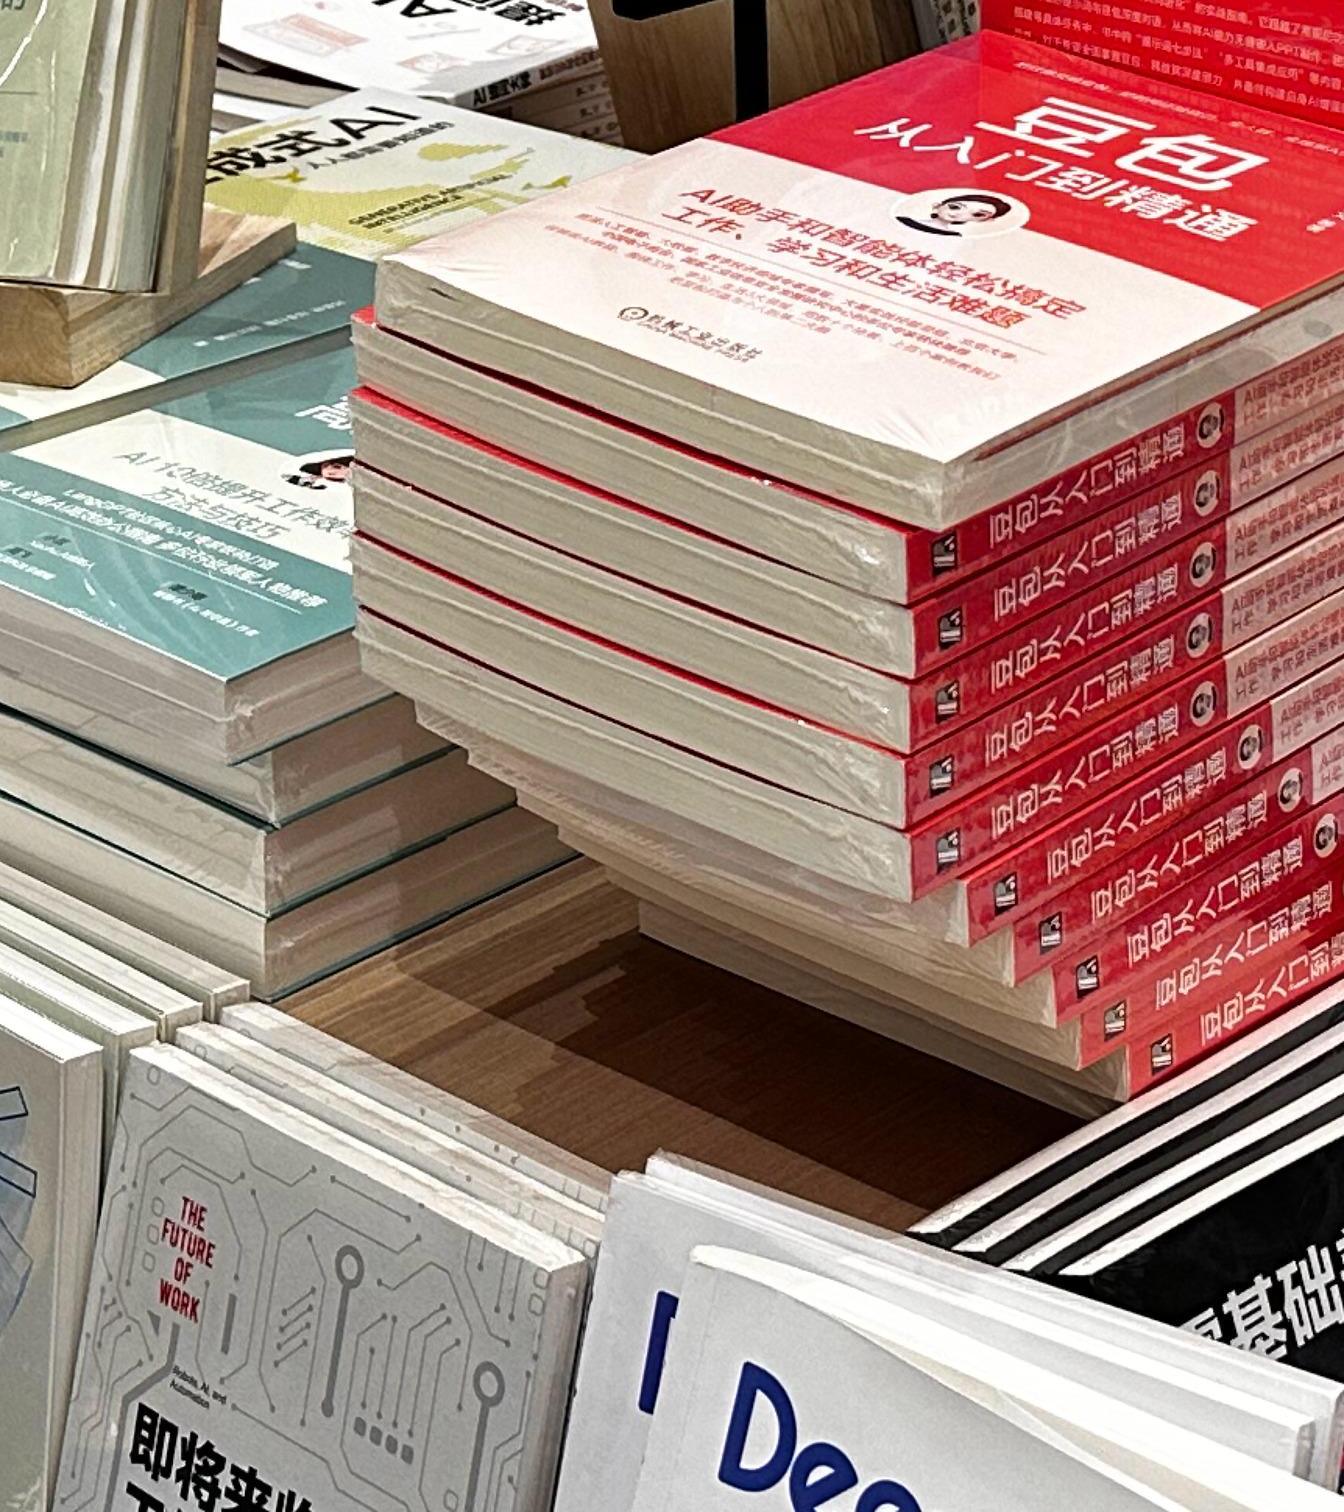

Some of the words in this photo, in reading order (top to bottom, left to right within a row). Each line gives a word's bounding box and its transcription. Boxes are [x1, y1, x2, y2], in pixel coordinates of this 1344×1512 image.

[206, 106, 422, 186] 成式AI
[854, 117, 1258, 242] 从入门到精通
[974, 96, 1269, 190] 豆包
[662, 206, 1032, 330] 工作、学习和生活难题
[677, 188, 1087, 319] AI助手和智能体轻松搞定
[143, 485, 291, 539] 方法与技巧
[990, 423, 1186, 548] 豆包从入门到精通
[993, 490, 1184, 620] 豆包从入门到精通
[986, 631, 1176, 764] 豆包从入门到精通
[1047, 742, 1228, 883] 豆包从入门到精通
[1090, 784, 1268, 922] 豆包从入门到精通
[1155, 880, 1335, 1010] 豆包从入门到精通
[160, 1217, 215, 1271] FUTURE
[173, 1252, 193, 1285] OF
[182, 1195, 207, 1232] THE
[158, 1277, 201, 1325] WORK
[129, 1402, 318, 1512] 即将来
